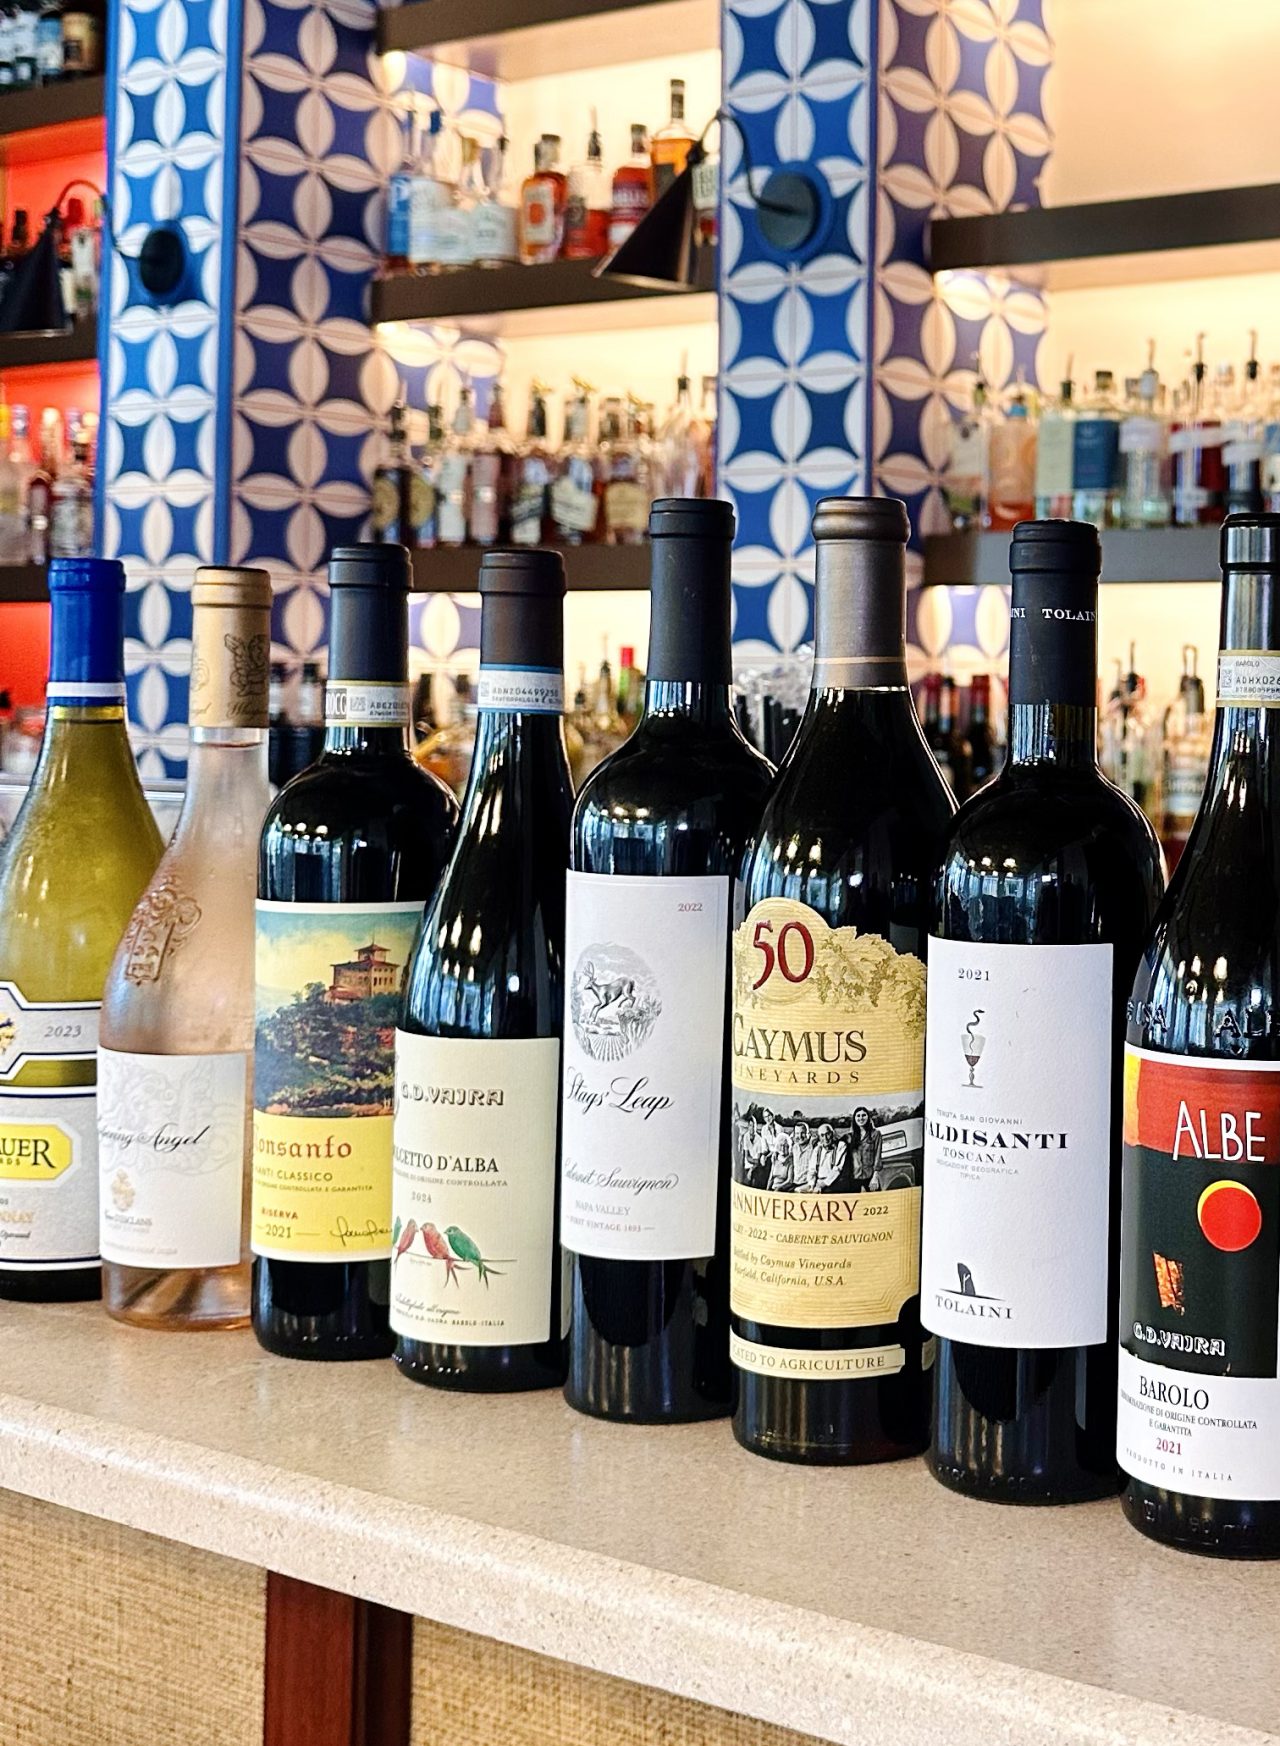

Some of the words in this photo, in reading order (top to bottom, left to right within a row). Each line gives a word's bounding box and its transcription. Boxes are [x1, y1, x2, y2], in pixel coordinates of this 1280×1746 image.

[677, 901, 703, 913] 2022
[752, 919, 815, 990] 50
[957, 967, 990, 982] 2021
[43, 1025, 82, 1038] 2023
[733, 1012, 868, 1063] CAYMUS
[608, 1076, 676, 1121] Leap
[959, 1113, 976, 1123] SAN
[979, 1116, 1024, 1126] GIOVANNI
[137, 1122, 212, 1153] Angel
[1172, 1099, 1266, 1163] ALBE
[0, 1137, 57, 1169] UER
[942, 1146, 1007, 1165] TOSCANA
[436, 1155, 500, 1173] D'ALBA
[276, 1169, 334, 1182] CLASSICO
[597, 1166, 680, 1197] Sauvignon
[260, 1206, 300, 1221] RISERVA
[595, 1202, 631, 1216] VALLEY
[862, 1205, 890, 1217] 2022
[264, 1223, 293, 1239] 2021
[748, 1228, 769, 1242] 2022
[775, 1232, 829, 1246] CABERNET
[829, 1229, 895, 1245] SAUVIGNON
[760, 1254, 796, 1270] Caymus
[798, 1257, 853, 1272] Vineyards
[760, 1270, 811, 1288] California,
[935, 1294, 1013, 1320] TOLAINI
[760, 1352, 776, 1369] TO
[779, 1355, 886, 1372] AGRICULTURE
[1139, 1374, 1210, 1411] BAROLO
[1155, 1405, 1164, 1417] DI
[1164, 1410, 1196, 1425] ORIGINE
[1197, 1416, 1258, 1430] CONTROLLATA
[1154, 1419, 1193, 1437] GARANTITA
[1155, 1437, 1182, 1456] 2021
[1172, 1466, 1184, 1475] IN
[1191, 1470, 1233, 1482] ITALIA
